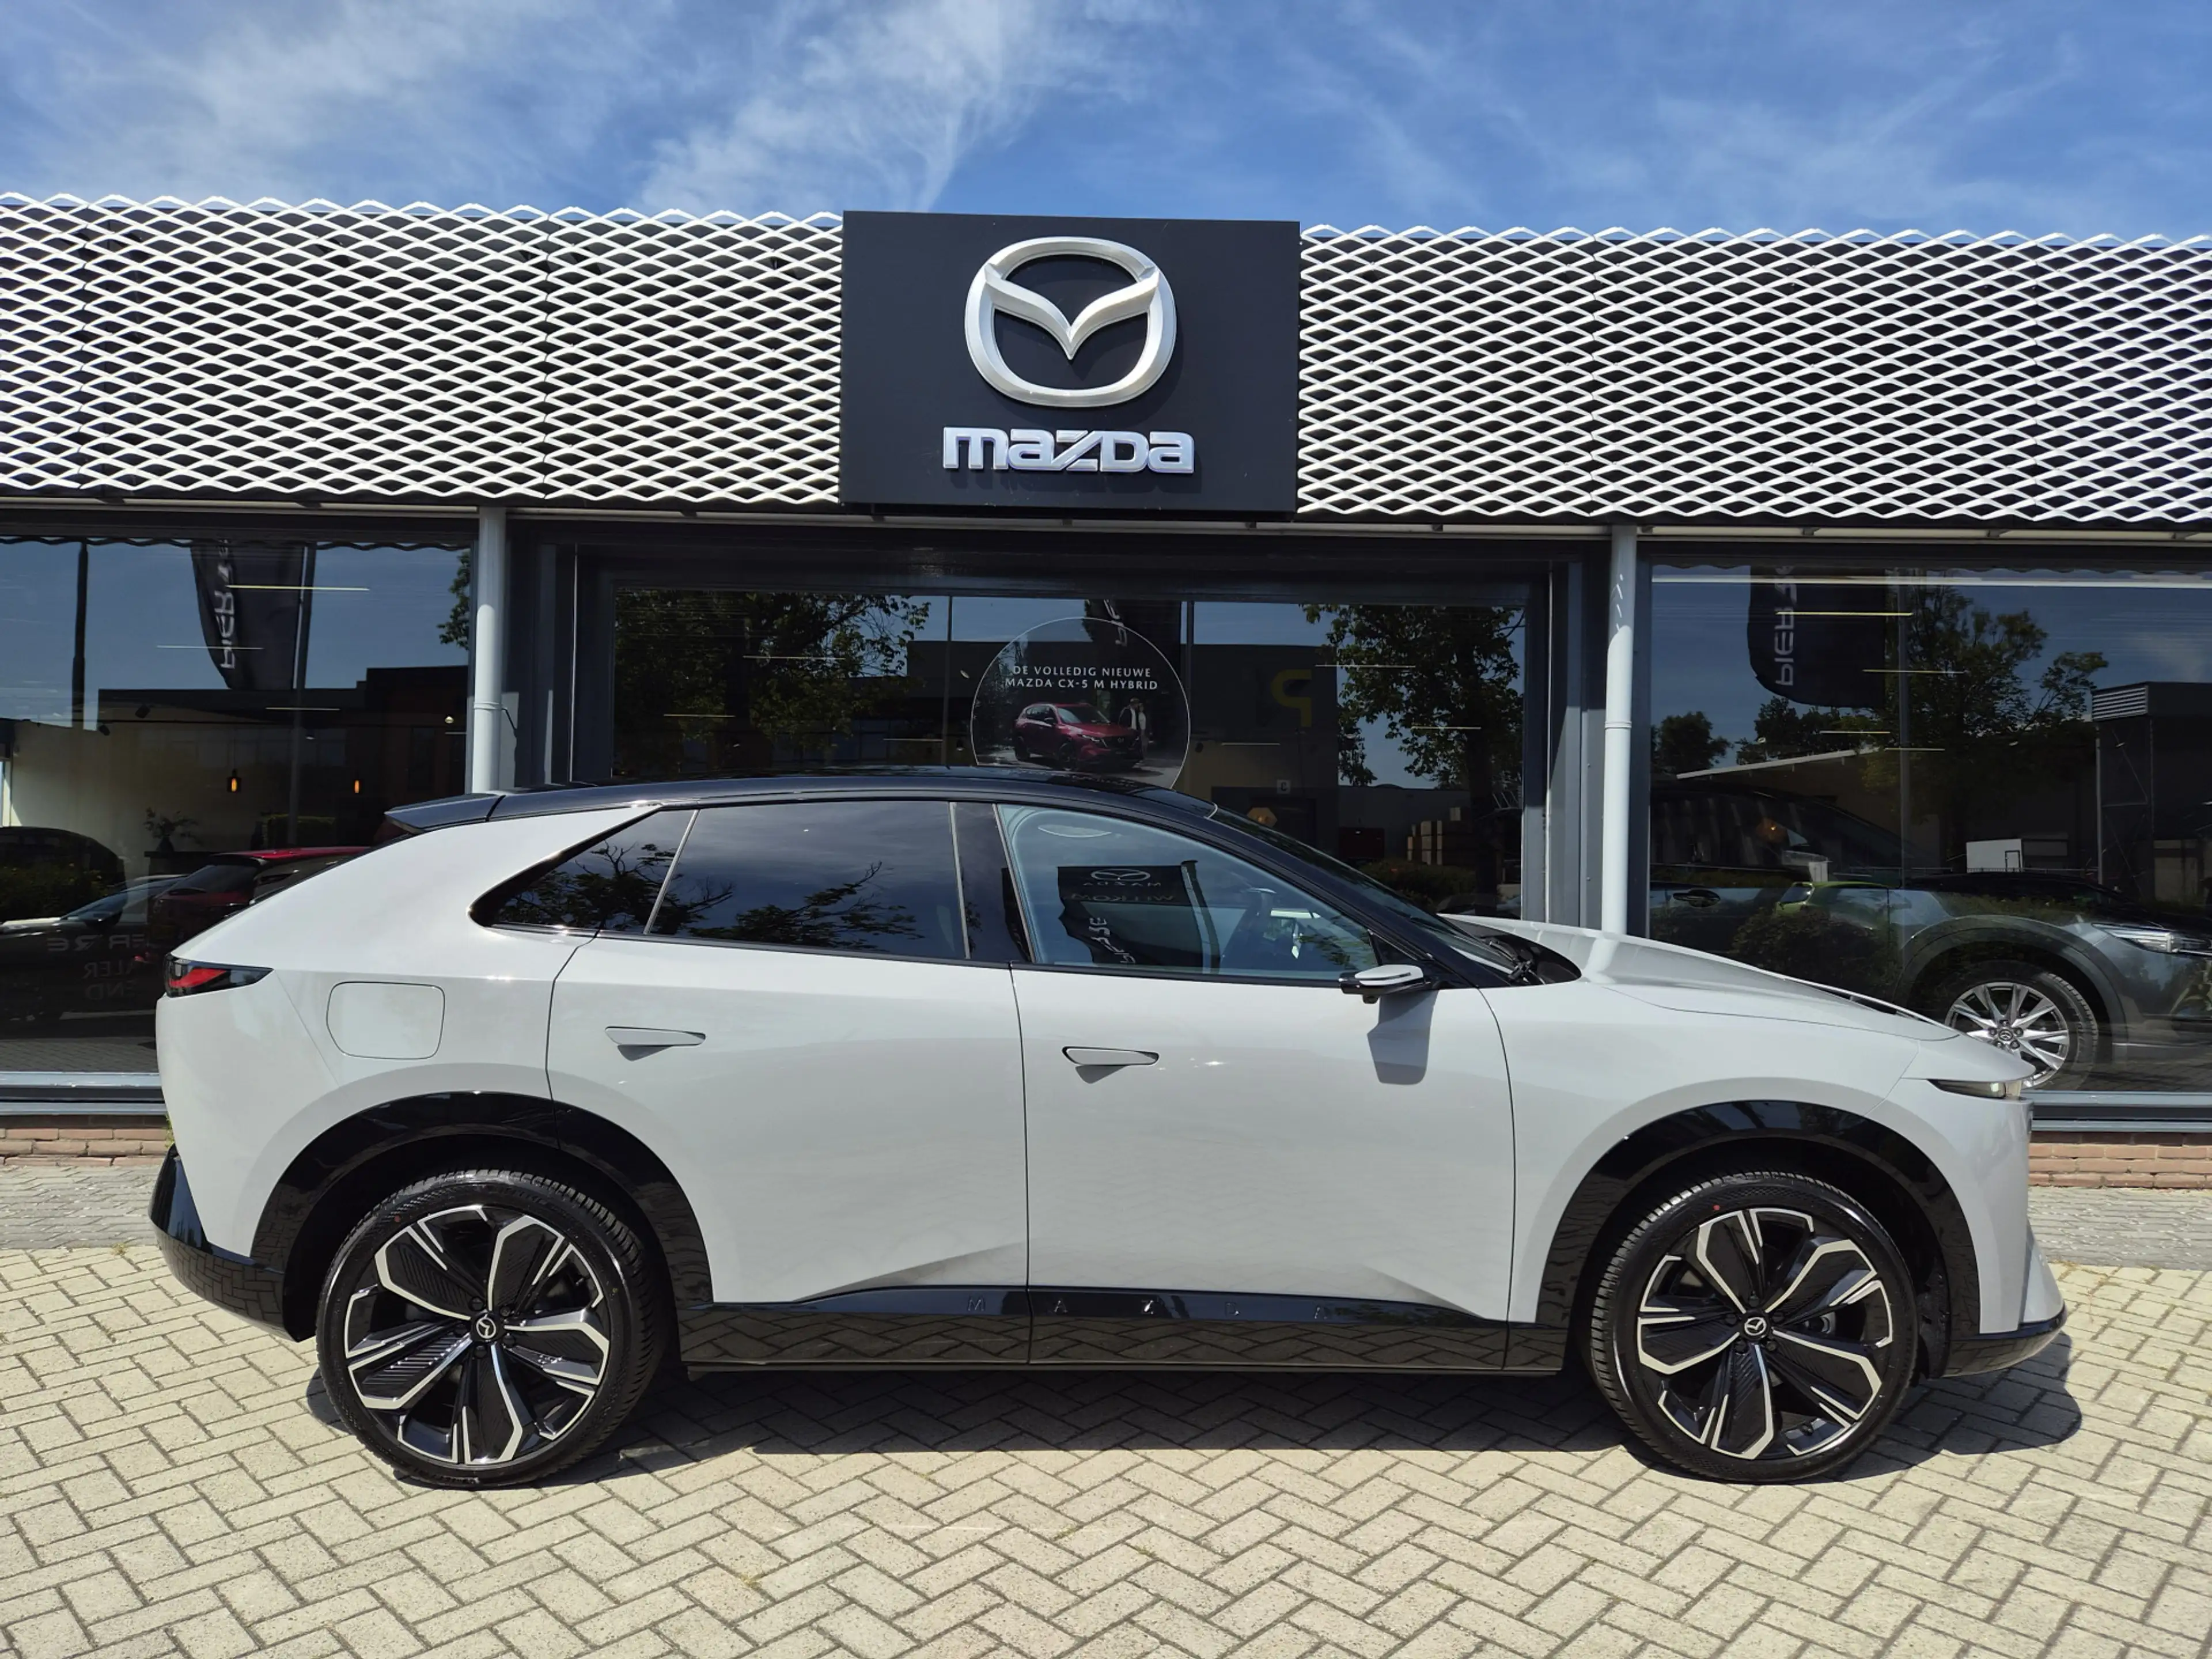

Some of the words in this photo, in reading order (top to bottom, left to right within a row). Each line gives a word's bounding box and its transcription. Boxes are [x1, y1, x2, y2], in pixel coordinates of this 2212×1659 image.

[1013, 665, 1029, 675] DE
[1033, 665, 1097, 676] VOLLEDIG
[1101, 668, 1151, 677] NIEUWE
[1005, 678, 1052, 688] MAZDA
[1058, 679, 1088, 688] CX-5
[1094, 680, 1105, 689] M
[1109, 680, 1158, 690] HYBRID
